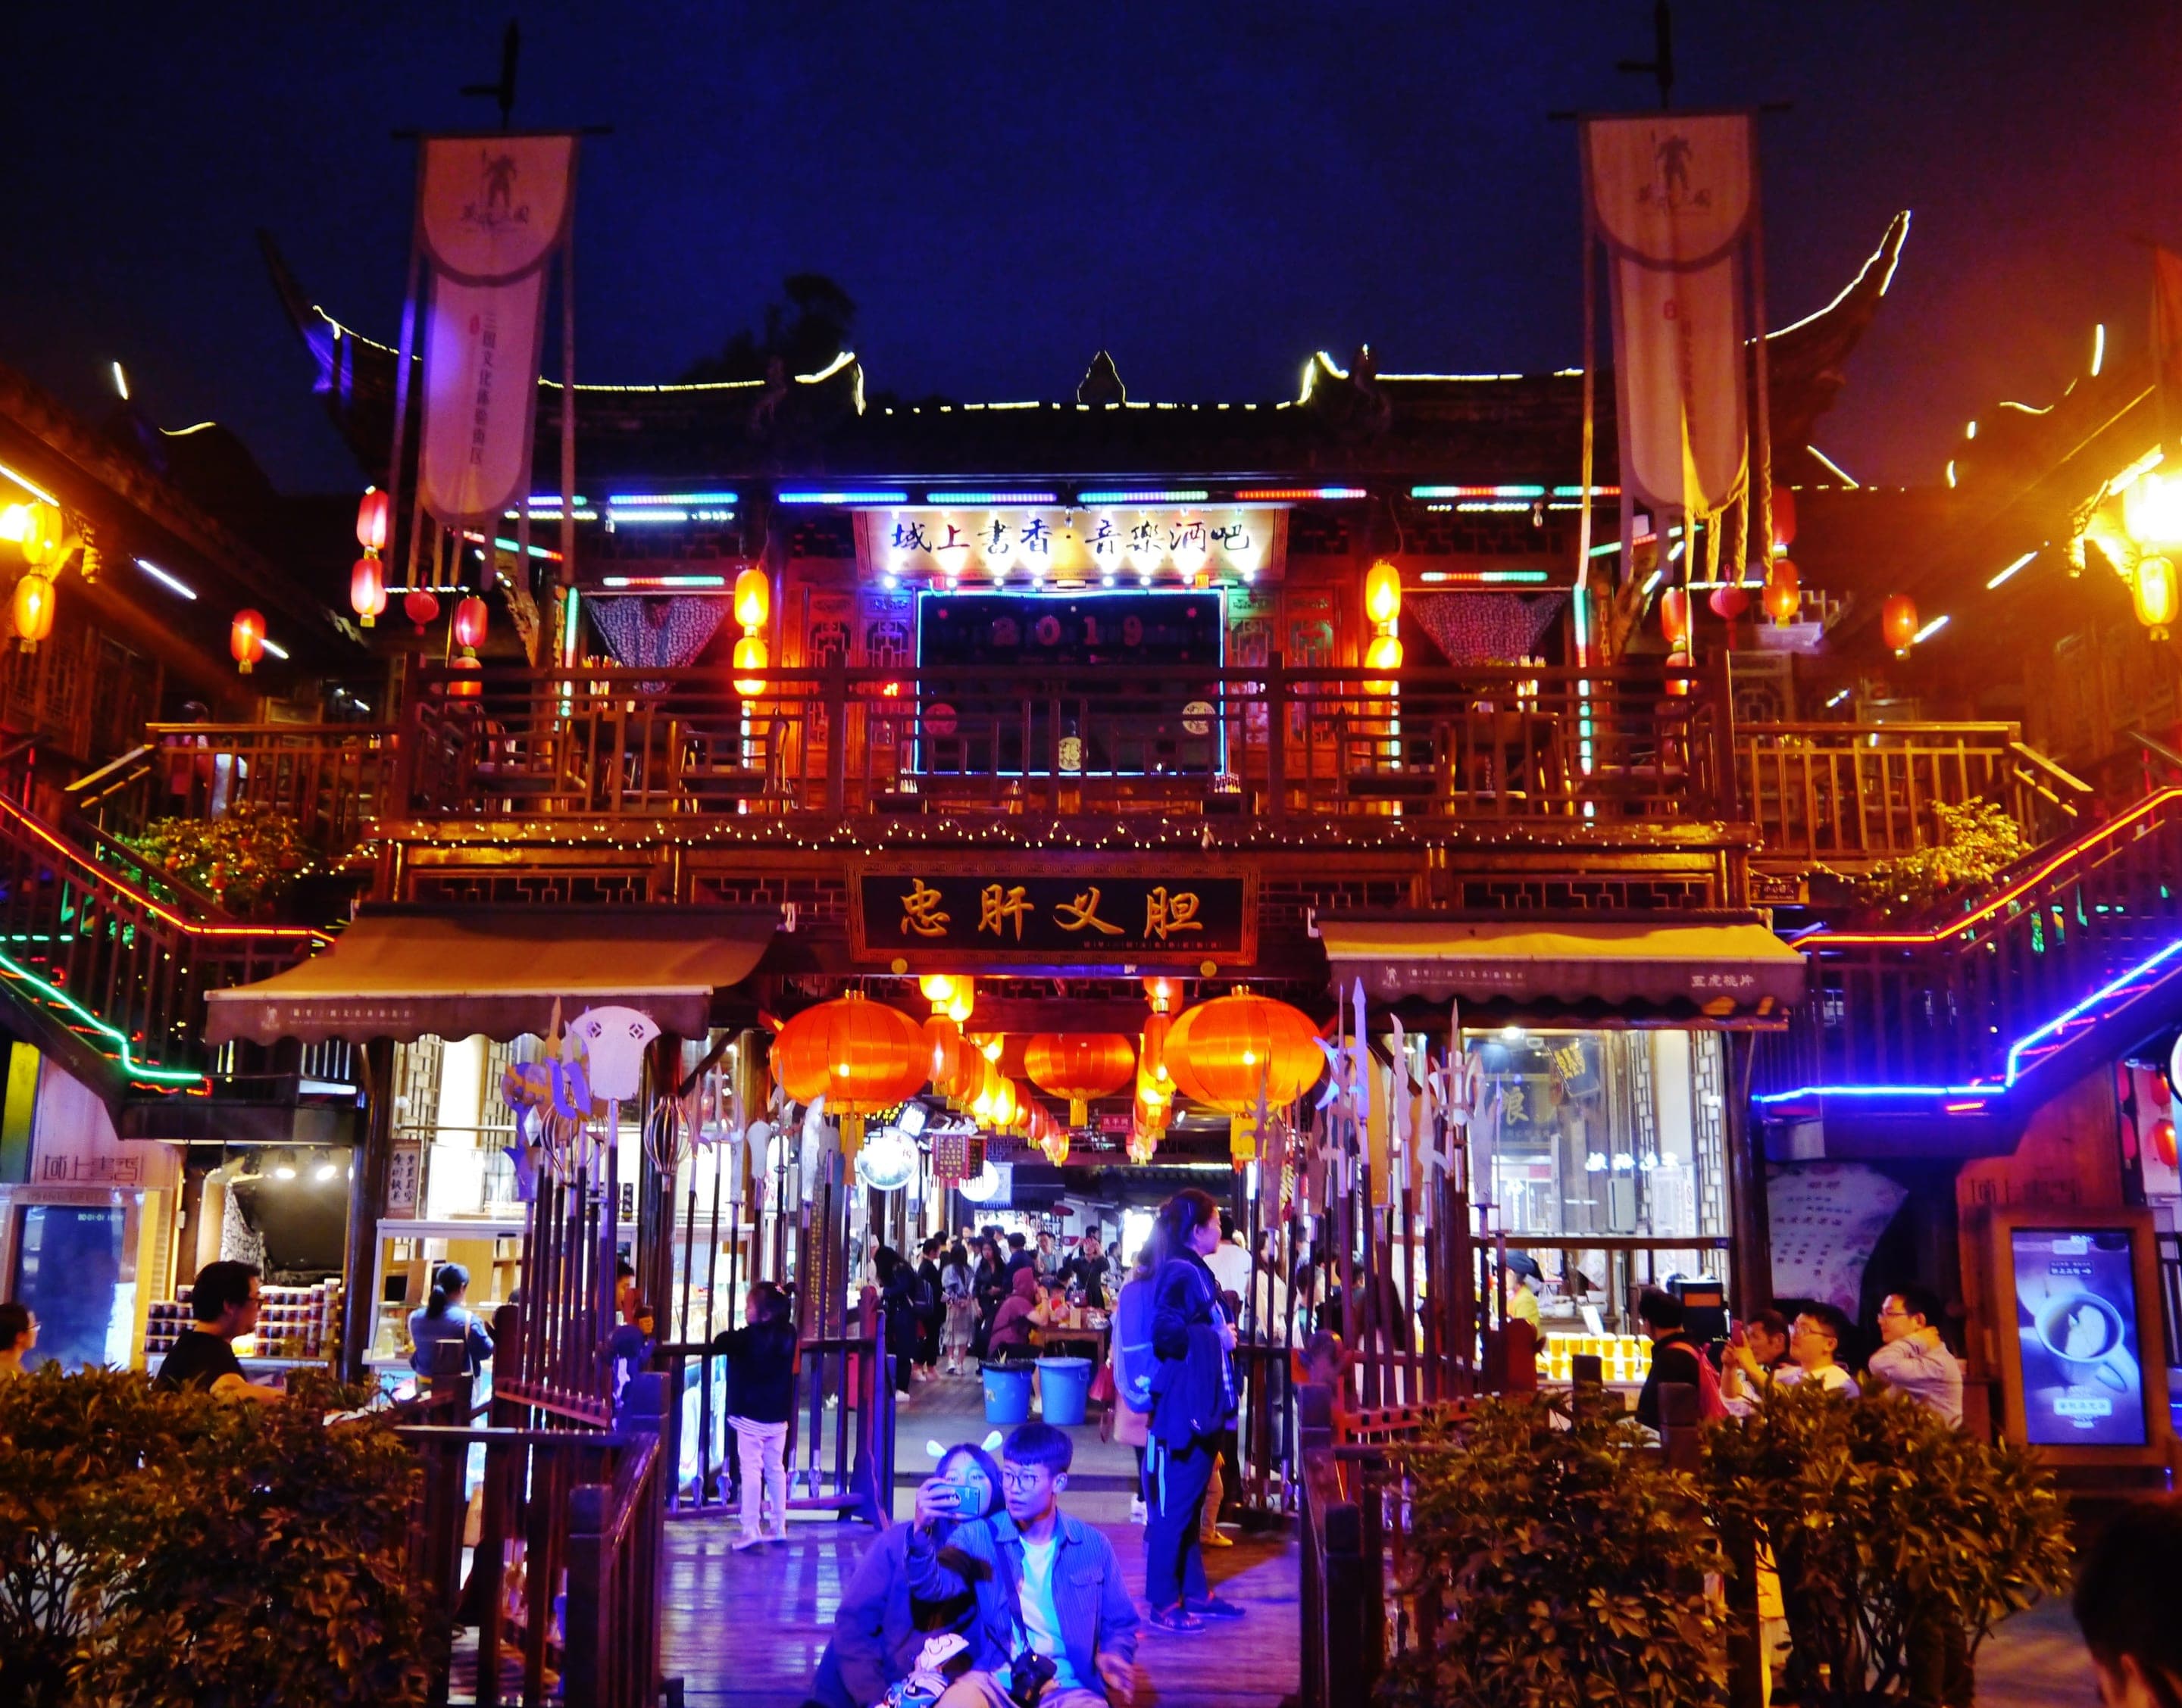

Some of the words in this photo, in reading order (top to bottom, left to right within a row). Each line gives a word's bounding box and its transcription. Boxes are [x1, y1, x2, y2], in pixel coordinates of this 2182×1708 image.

[991, 614, 1143, 648] 2019
[898, 877, 1204, 942] 忠肝义胆
